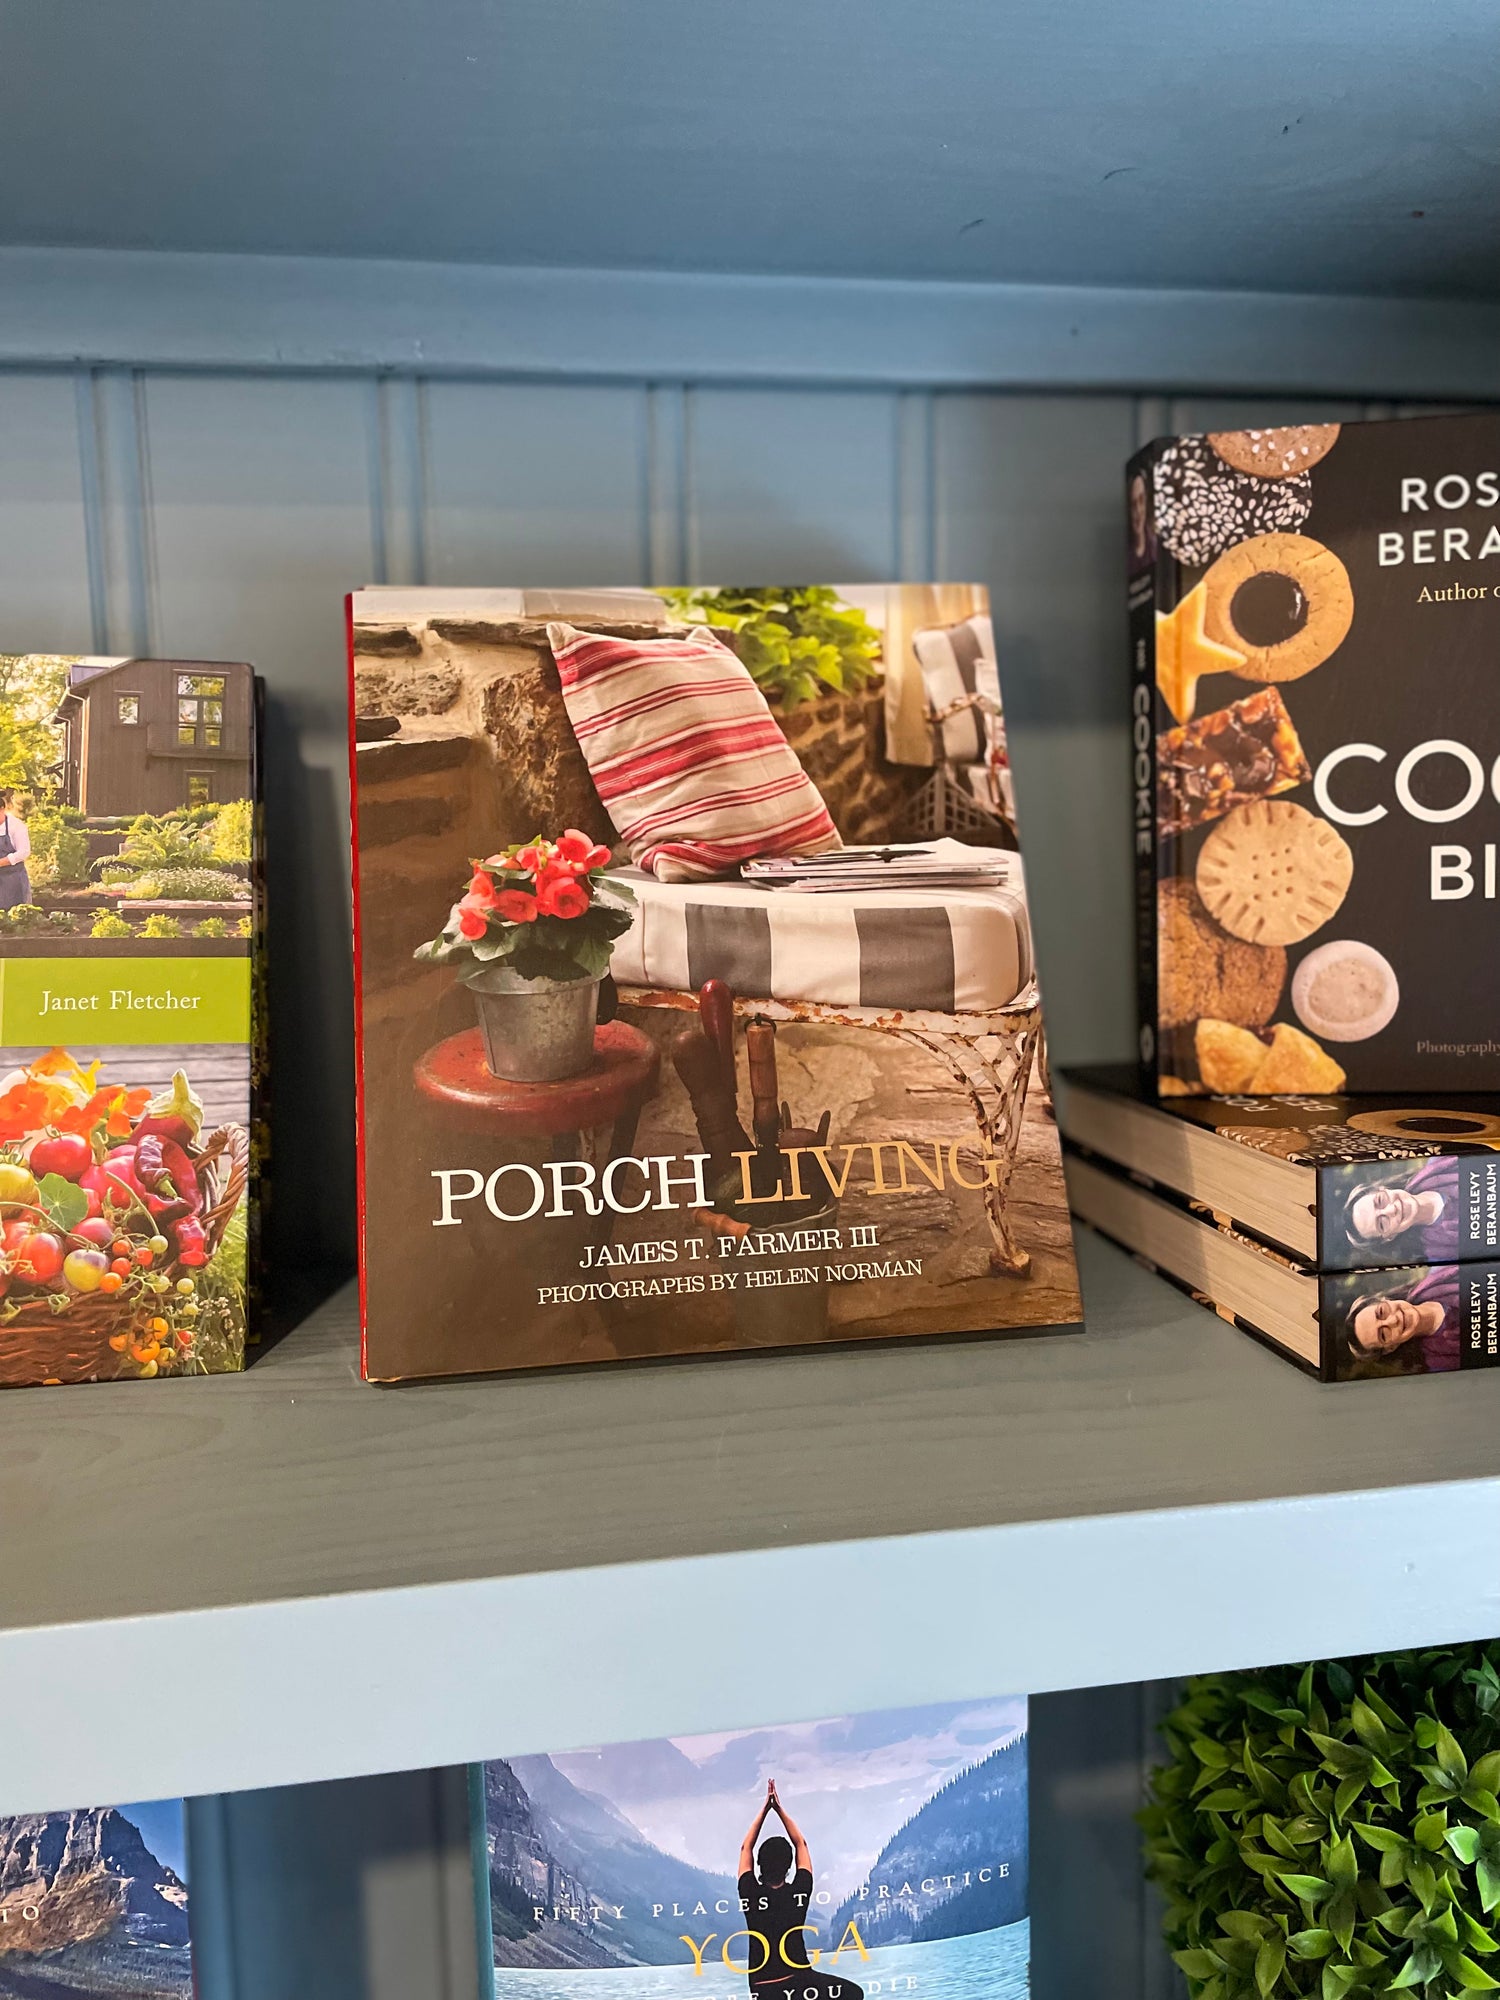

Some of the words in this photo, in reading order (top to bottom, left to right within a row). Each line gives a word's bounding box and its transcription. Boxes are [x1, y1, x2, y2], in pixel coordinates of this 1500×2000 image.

[1401, 472, 1500, 513] ROS
[1417, 582, 1488, 603] Author
[1313, 738, 1500, 828] CO
[1430, 843, 1498, 901] BI
[38, 990, 100, 1016] Janet
[109, 989, 201, 1011] Fletcher
[430, 1153, 716, 1228] PORCH
[731, 1137, 1004, 1207] LIVING
[1469, 1171, 1481, 1204] LEVY
[1469, 1206, 1481, 1240] ROSE
[1486, 1163, 1498, 1246] BERANBAUM
[579, 1240, 678, 1269] JAMES
[683, 1238, 710, 1261] T.
[718, 1228, 842, 1259] FARMER
[849, 1225, 880, 1248] III
[537, 1275, 704, 1305] PHOTOGRAPHS
[710, 1272, 740, 1292] BY
[744, 1266, 819, 1289] HELEN
[825, 1258, 923, 1284] NORMAN
[1470, 1281, 1482, 1314] LEVY
[1470, 1316, 1482, 1349] ROSE
[1487, 1273, 1499, 1355] BERANBAUM
[533, 1904, 627, 1921] FIFTY
[652, 1895, 770, 1919] PLACES
[793, 1890, 832, 1908] TO
[859, 1862, 1012, 1901] PRACTICE
[0, 1905, 40, 1923] TO
[678, 1920, 872, 1977] YOGA
[782, 1983, 844, 2000] YOU
[869, 1975, 919, 1992] DIE
